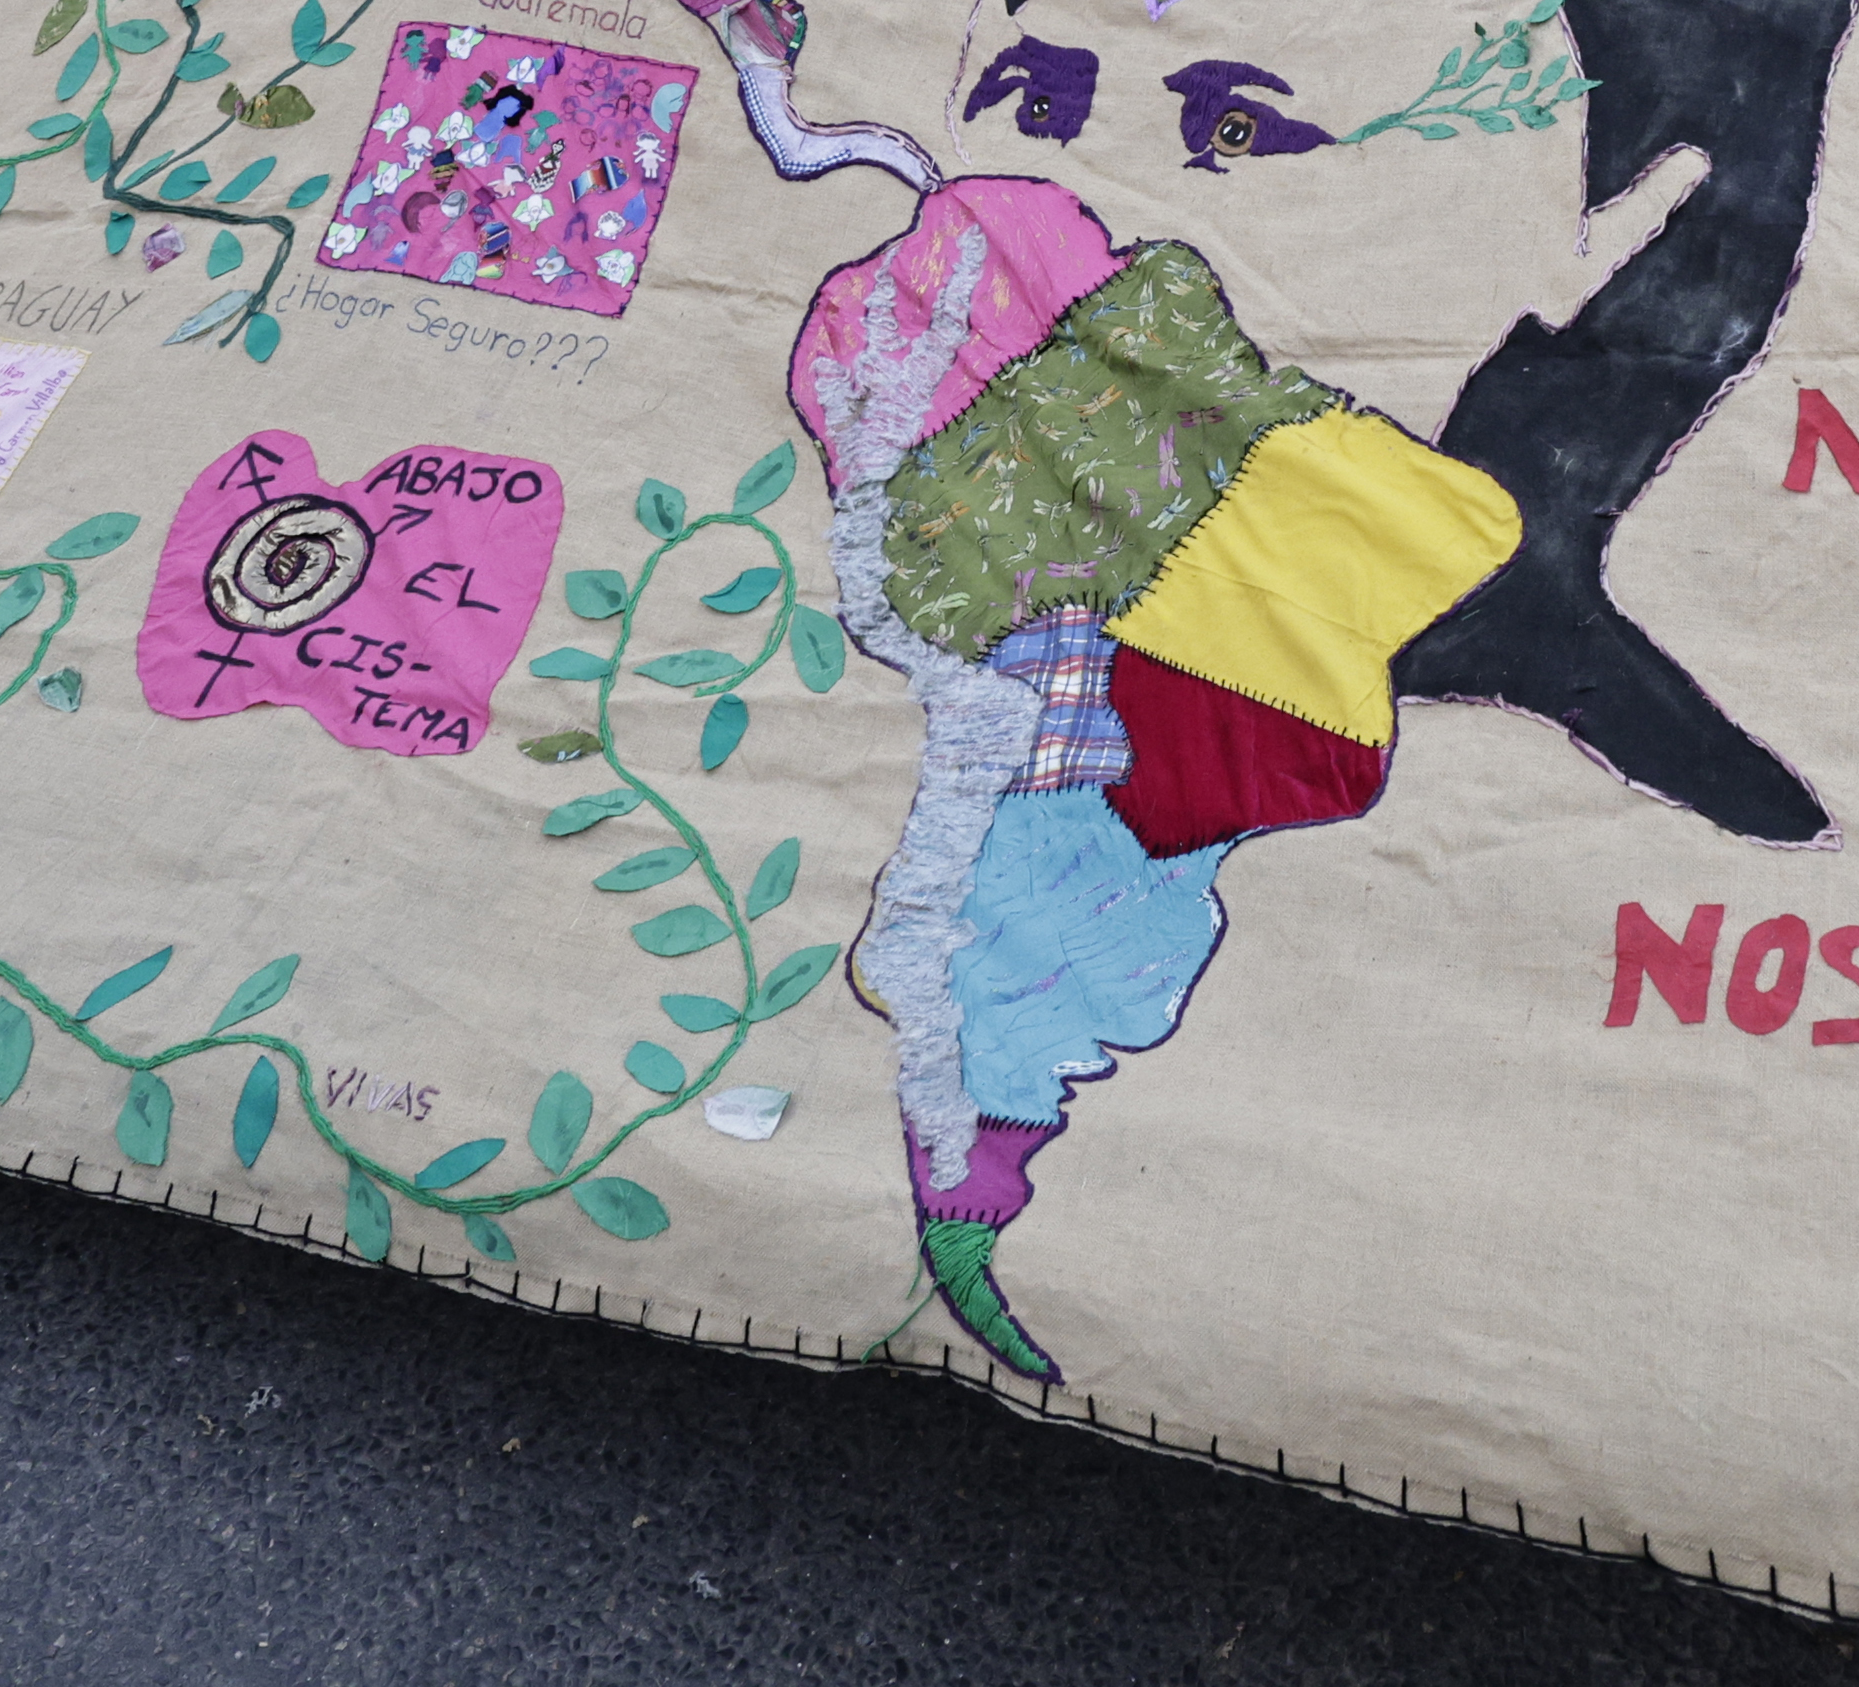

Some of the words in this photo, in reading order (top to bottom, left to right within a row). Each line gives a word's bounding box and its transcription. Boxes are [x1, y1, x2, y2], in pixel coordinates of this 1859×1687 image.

[407, 298, 611, 386] Seguro???
[25, 368, 68, 412] Villalba
[363, 452, 543, 504] ABAJO
[404, 562, 501, 614] EL
[294, 626, 433, 679] CIS-
[351, 685, 470, 752] TEMA
[325, 1067, 442, 1121] VIVAS
